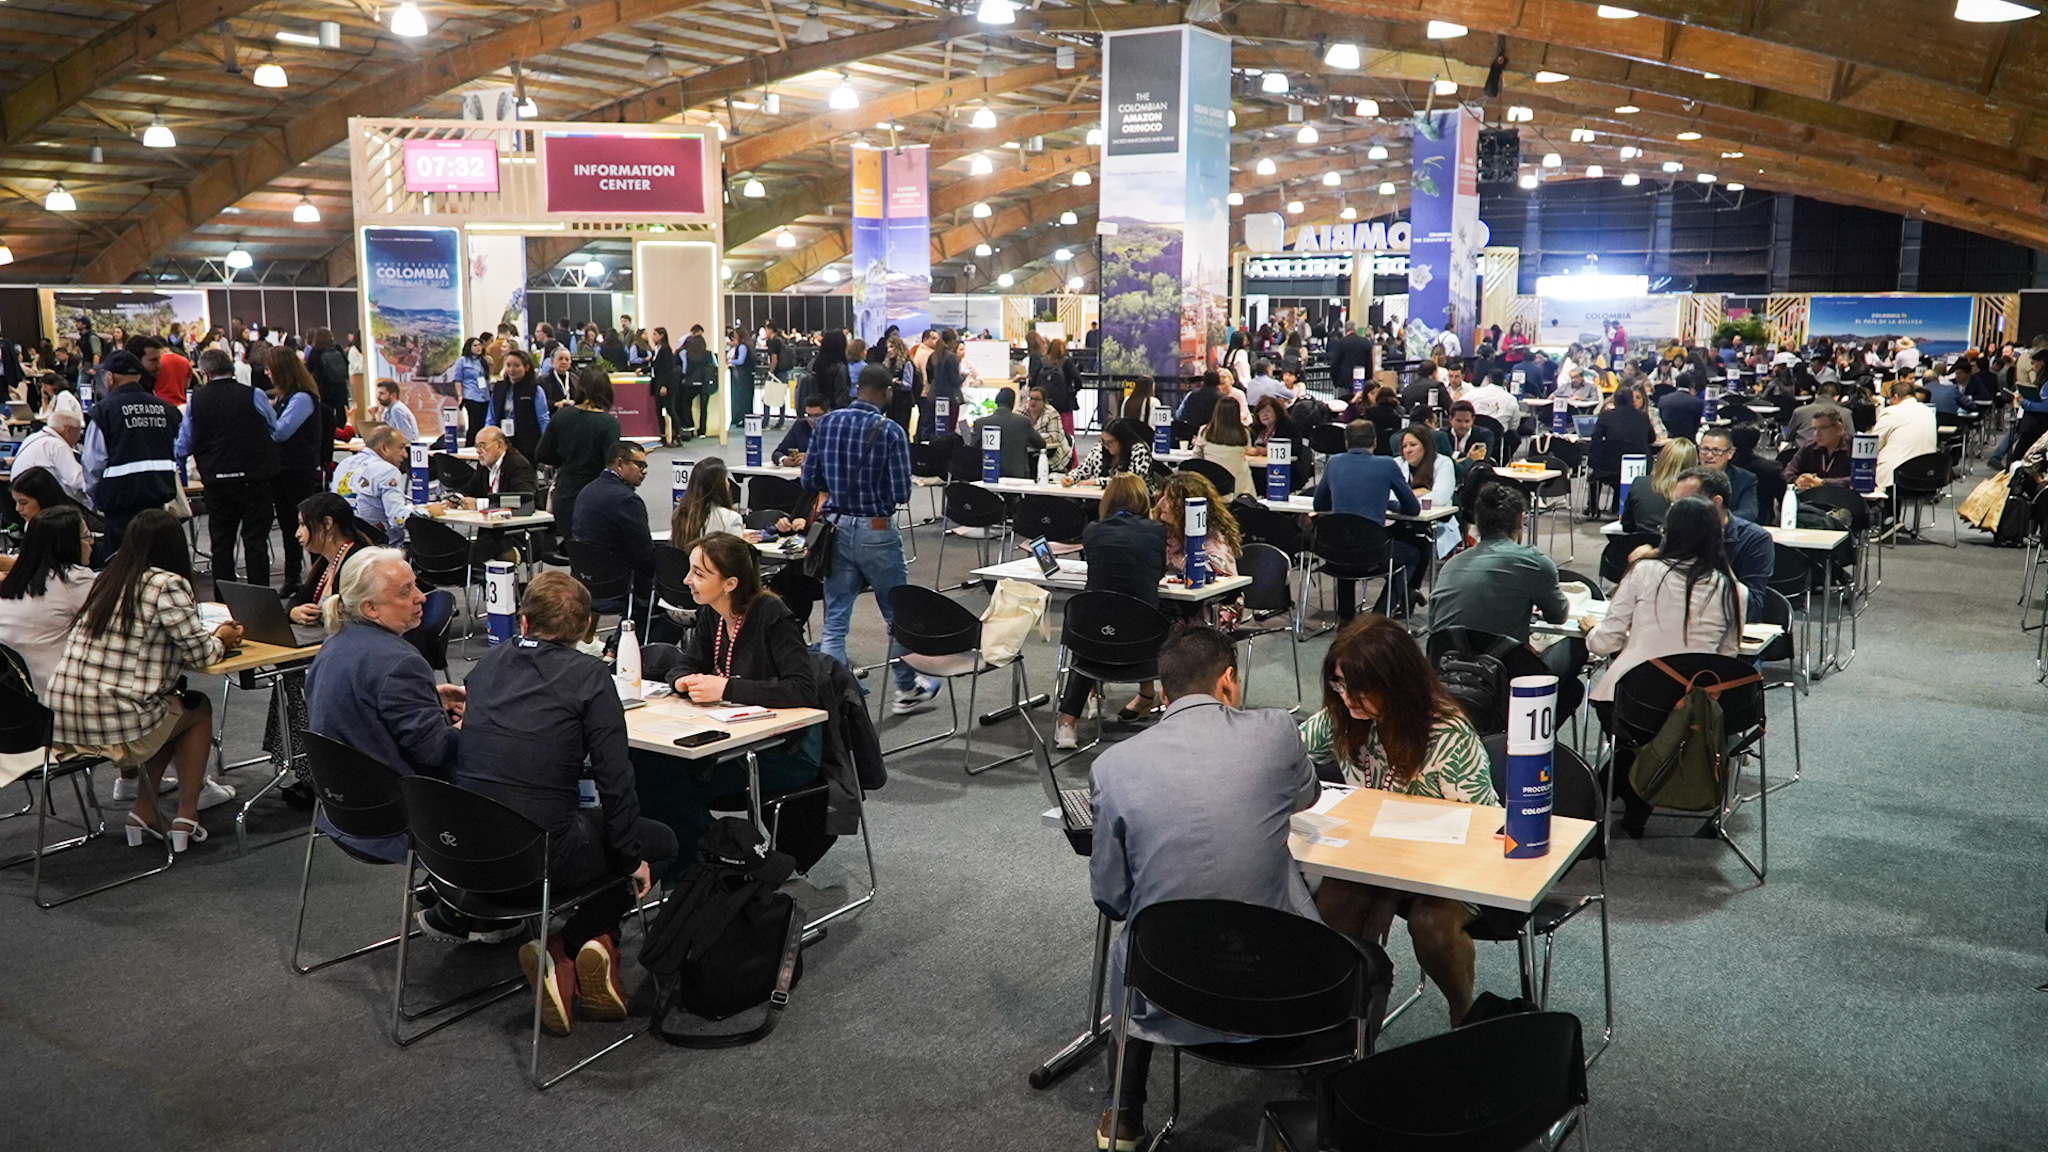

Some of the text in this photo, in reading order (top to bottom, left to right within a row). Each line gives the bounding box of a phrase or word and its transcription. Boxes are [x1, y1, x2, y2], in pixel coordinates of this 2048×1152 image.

[1136, 93, 1150, 101] THE
[1118, 102, 1168, 113] COLOMBIAN
[1123, 113, 1162, 123] AMAZON
[1122, 123, 1163, 134] ORINOCO
[416, 155, 485, 178] 07:32
[574, 164, 675, 176] INFORMATION
[599, 179, 651, 190] CENTER
[376, 267, 450, 280] COLOMBIA
[1585, 312, 1632, 320] COLOMBIA
[121, 404, 166, 416] OPERADOR
[1155, 413, 1168, 422] 119
[985, 434, 995, 446] 12
[1269, 447, 1286, 460] 113
[1857, 442, 1876, 454] 117
[412, 450, 422, 462] 10
[673, 470, 688, 484] 09
